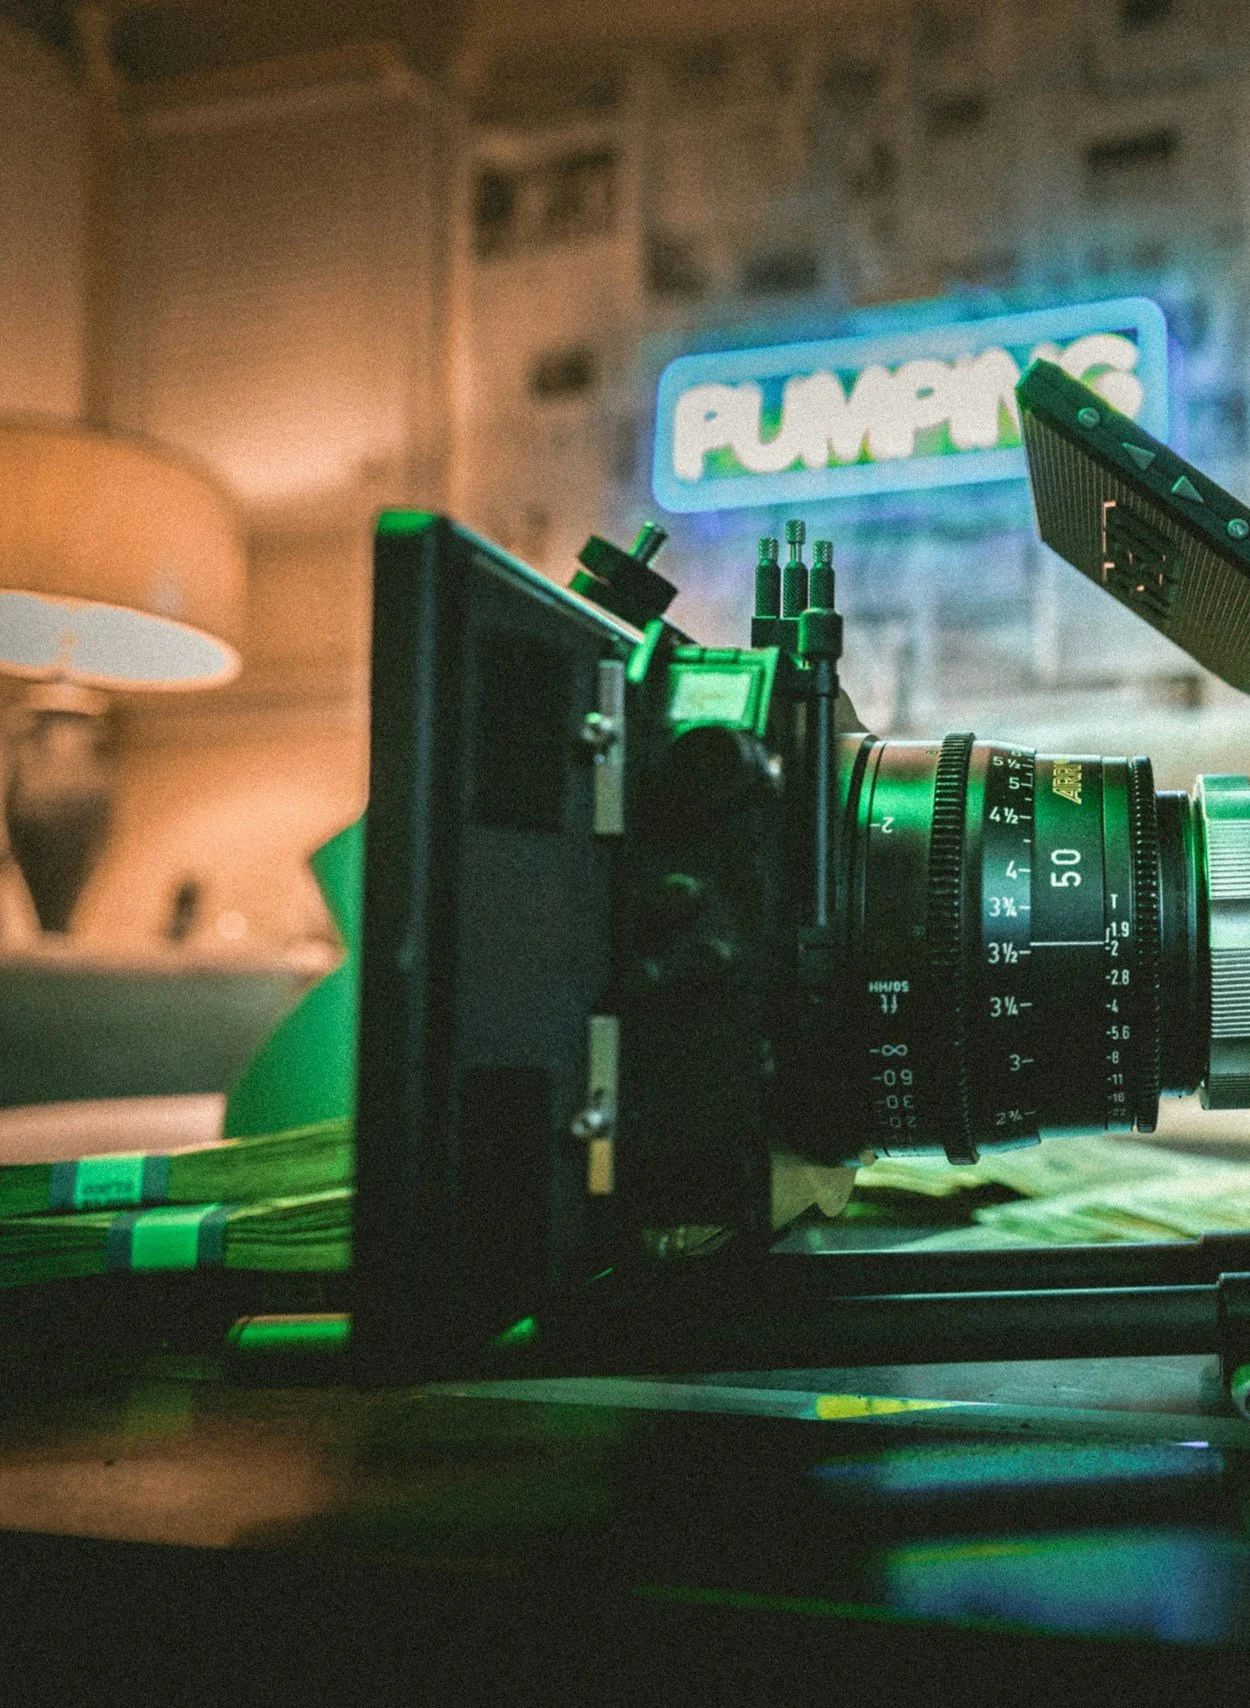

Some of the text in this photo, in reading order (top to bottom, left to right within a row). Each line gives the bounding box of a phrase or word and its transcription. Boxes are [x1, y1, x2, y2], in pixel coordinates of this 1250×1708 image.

[1008, 777, 1020, 789] 5
[881, 817, 894, 833] 2
[1005, 860, 1018, 879] 4
[1050, 849, 1081, 887] 50
[1110, 894, 1118, 909] T
[1110, 921, 1130, 937] 1.9
[1111, 970, 1130, 985] 2.8
[1111, 1026, 1130, 1039] 5.6
[1009, 1054, 1020, 1071] 3
